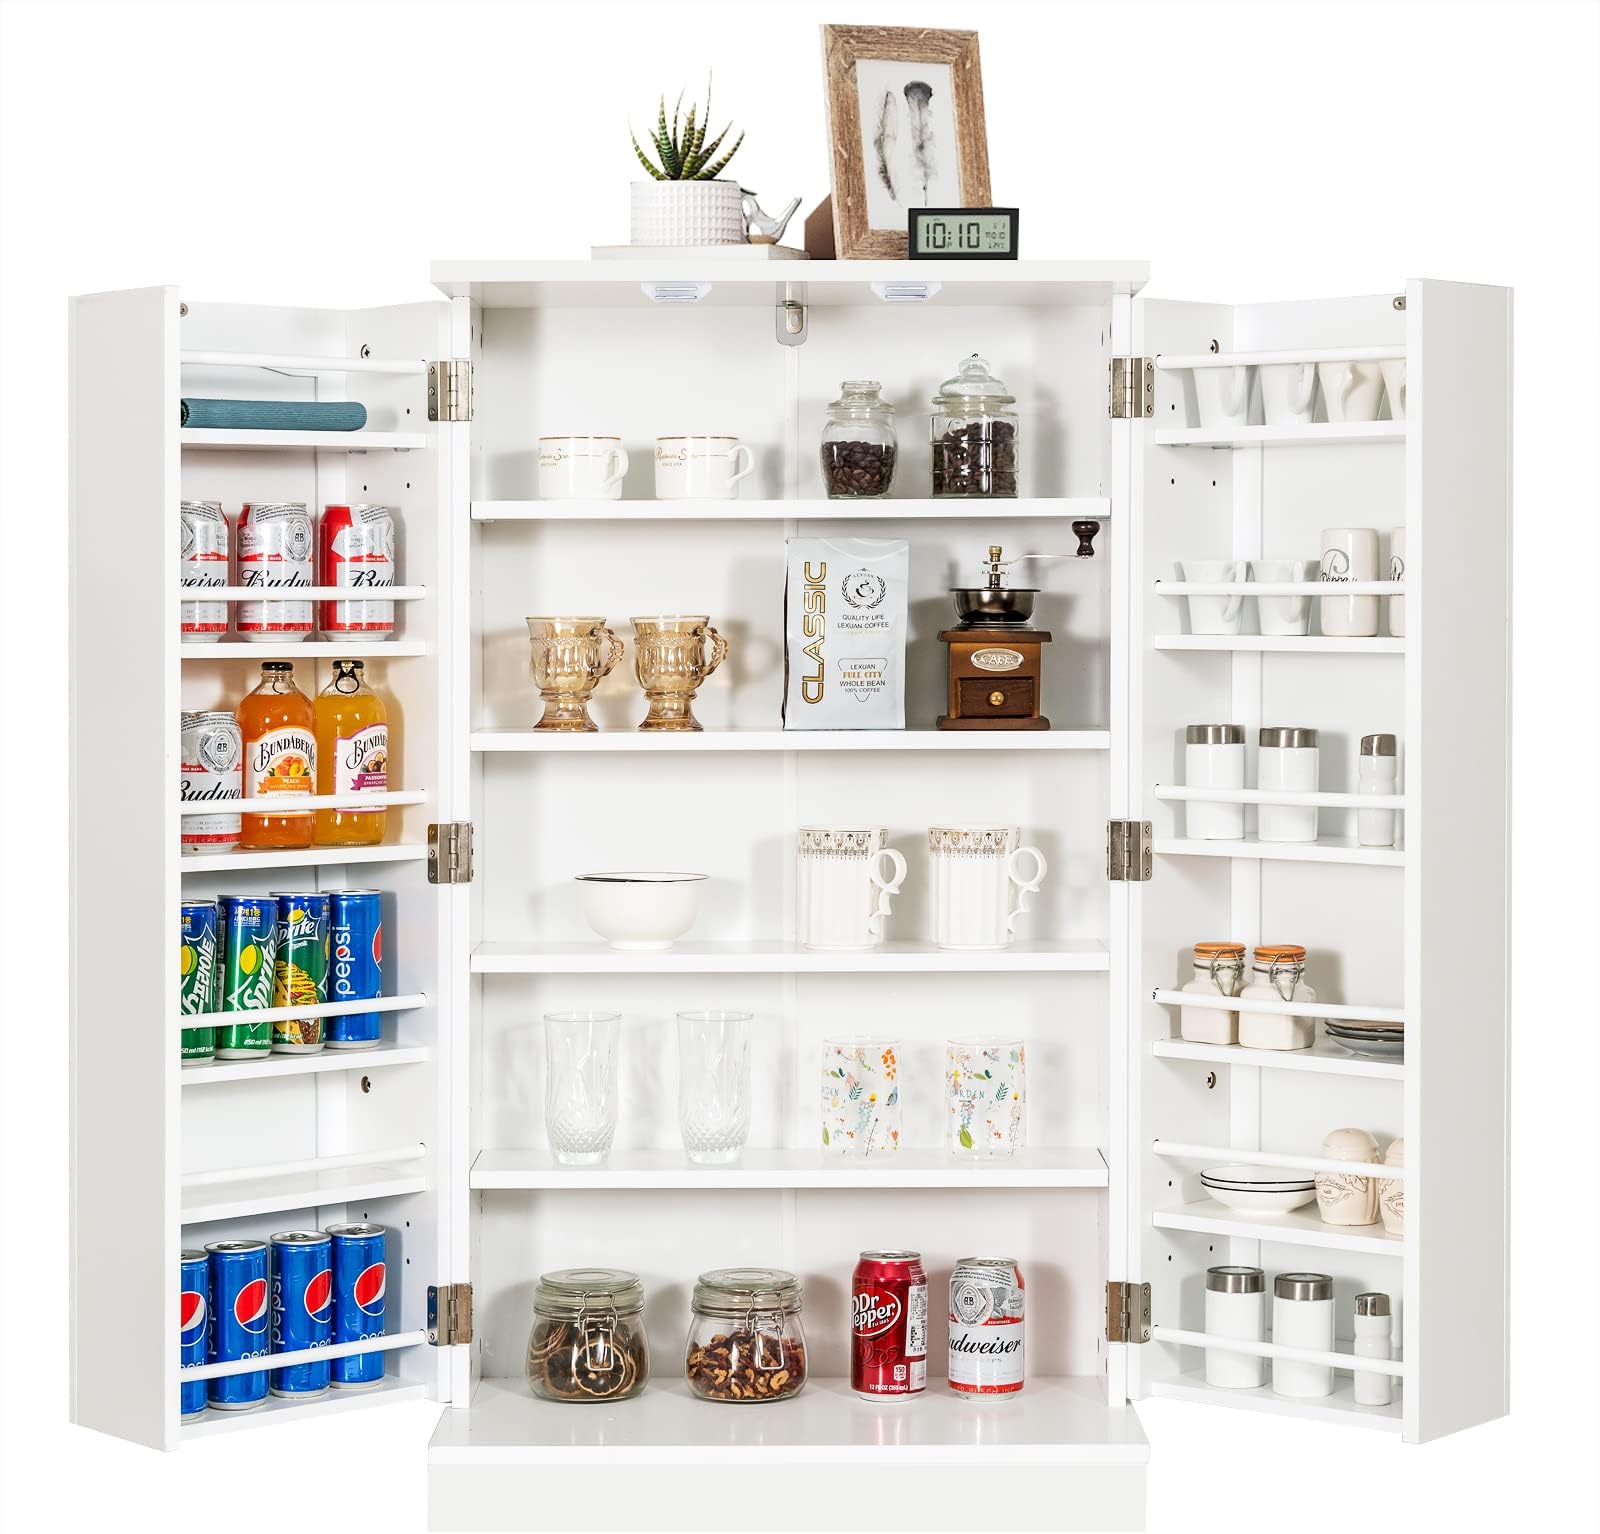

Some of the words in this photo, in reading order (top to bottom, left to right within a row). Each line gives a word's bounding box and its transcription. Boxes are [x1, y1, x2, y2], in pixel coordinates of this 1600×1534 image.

[926, 223, 980, 248] 10:10
[801, 561, 827, 704] CLASSIC
[864, 621, 889, 629] COFFEE
[253, 735, 316, 772] BUNDABERG
[278, 917, 316, 942] prite
[332, 924, 356, 995] pepsi
[860, 1292, 880, 1313] Dr
